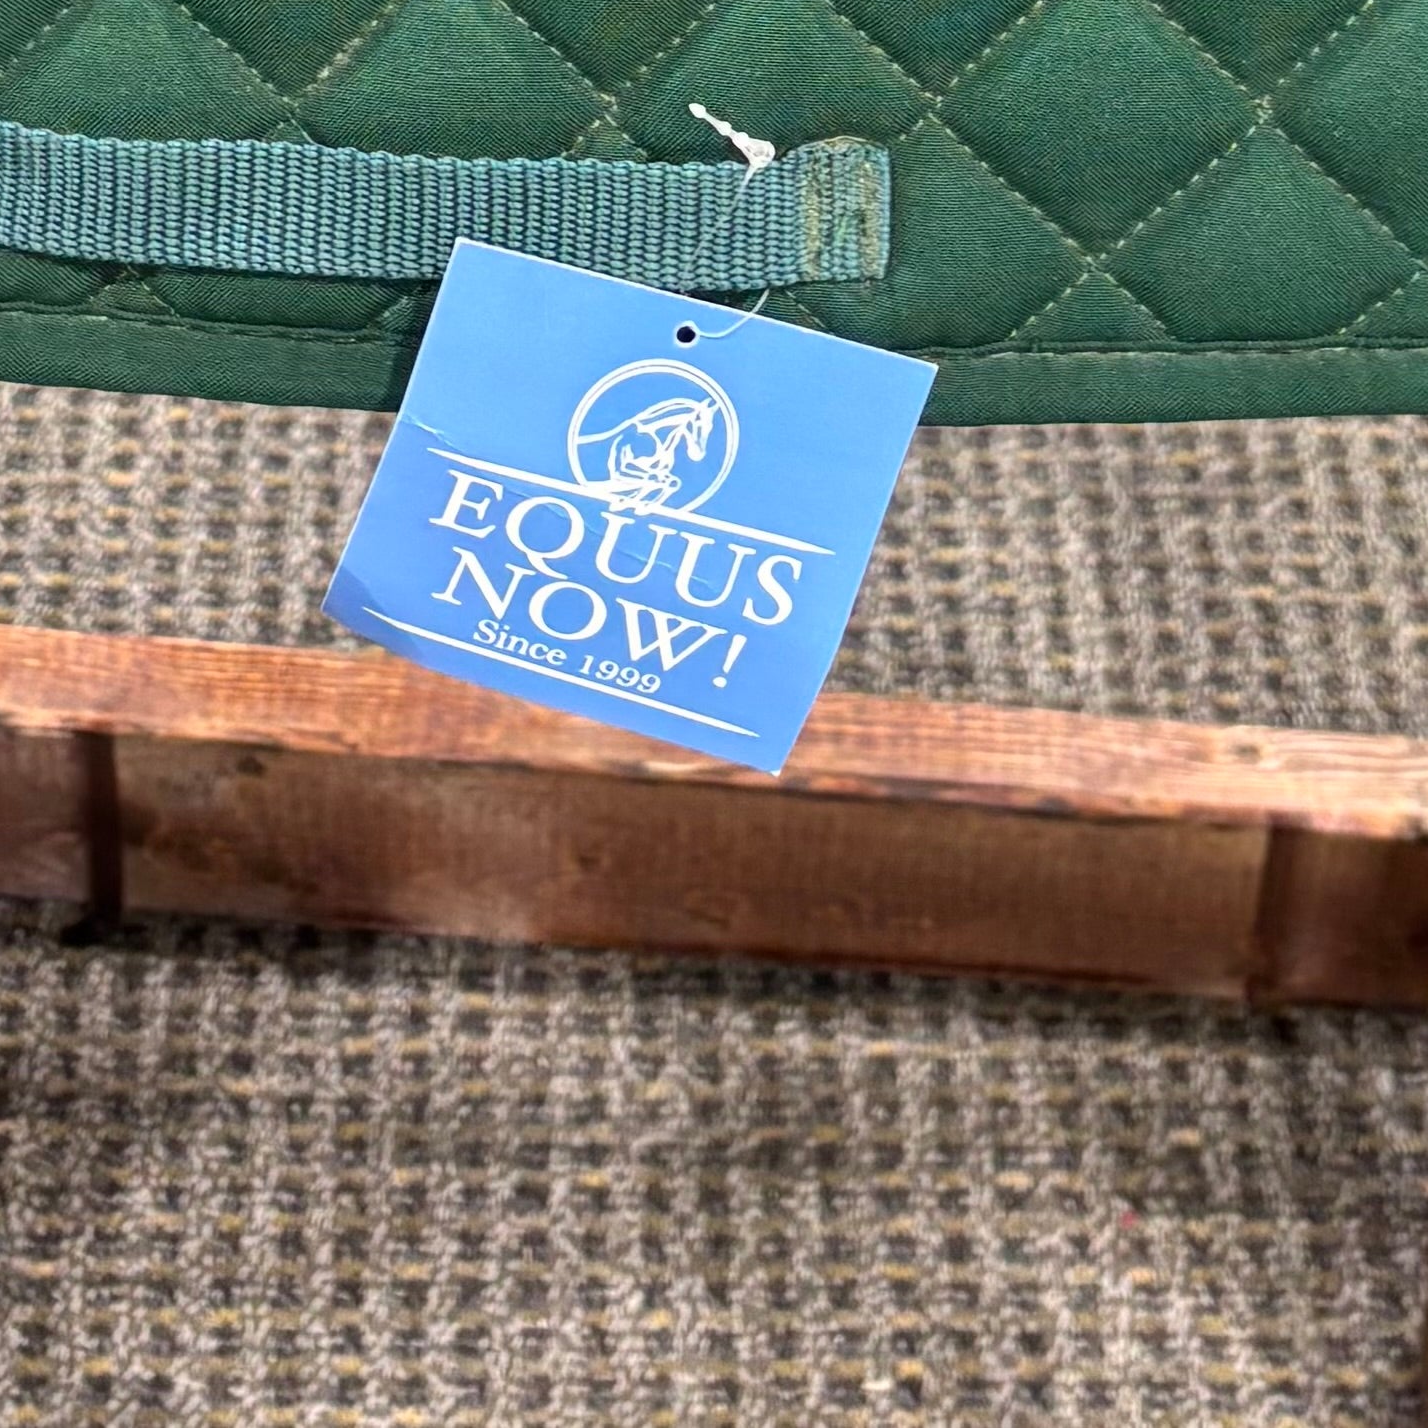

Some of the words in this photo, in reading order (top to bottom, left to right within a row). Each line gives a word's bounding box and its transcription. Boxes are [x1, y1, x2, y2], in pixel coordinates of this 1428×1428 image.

[428, 470, 802, 626] EQUUS
[431, 547, 748, 688] NOW!
[473, 619, 567, 666] Since
[579, 654, 661, 694] 1999
